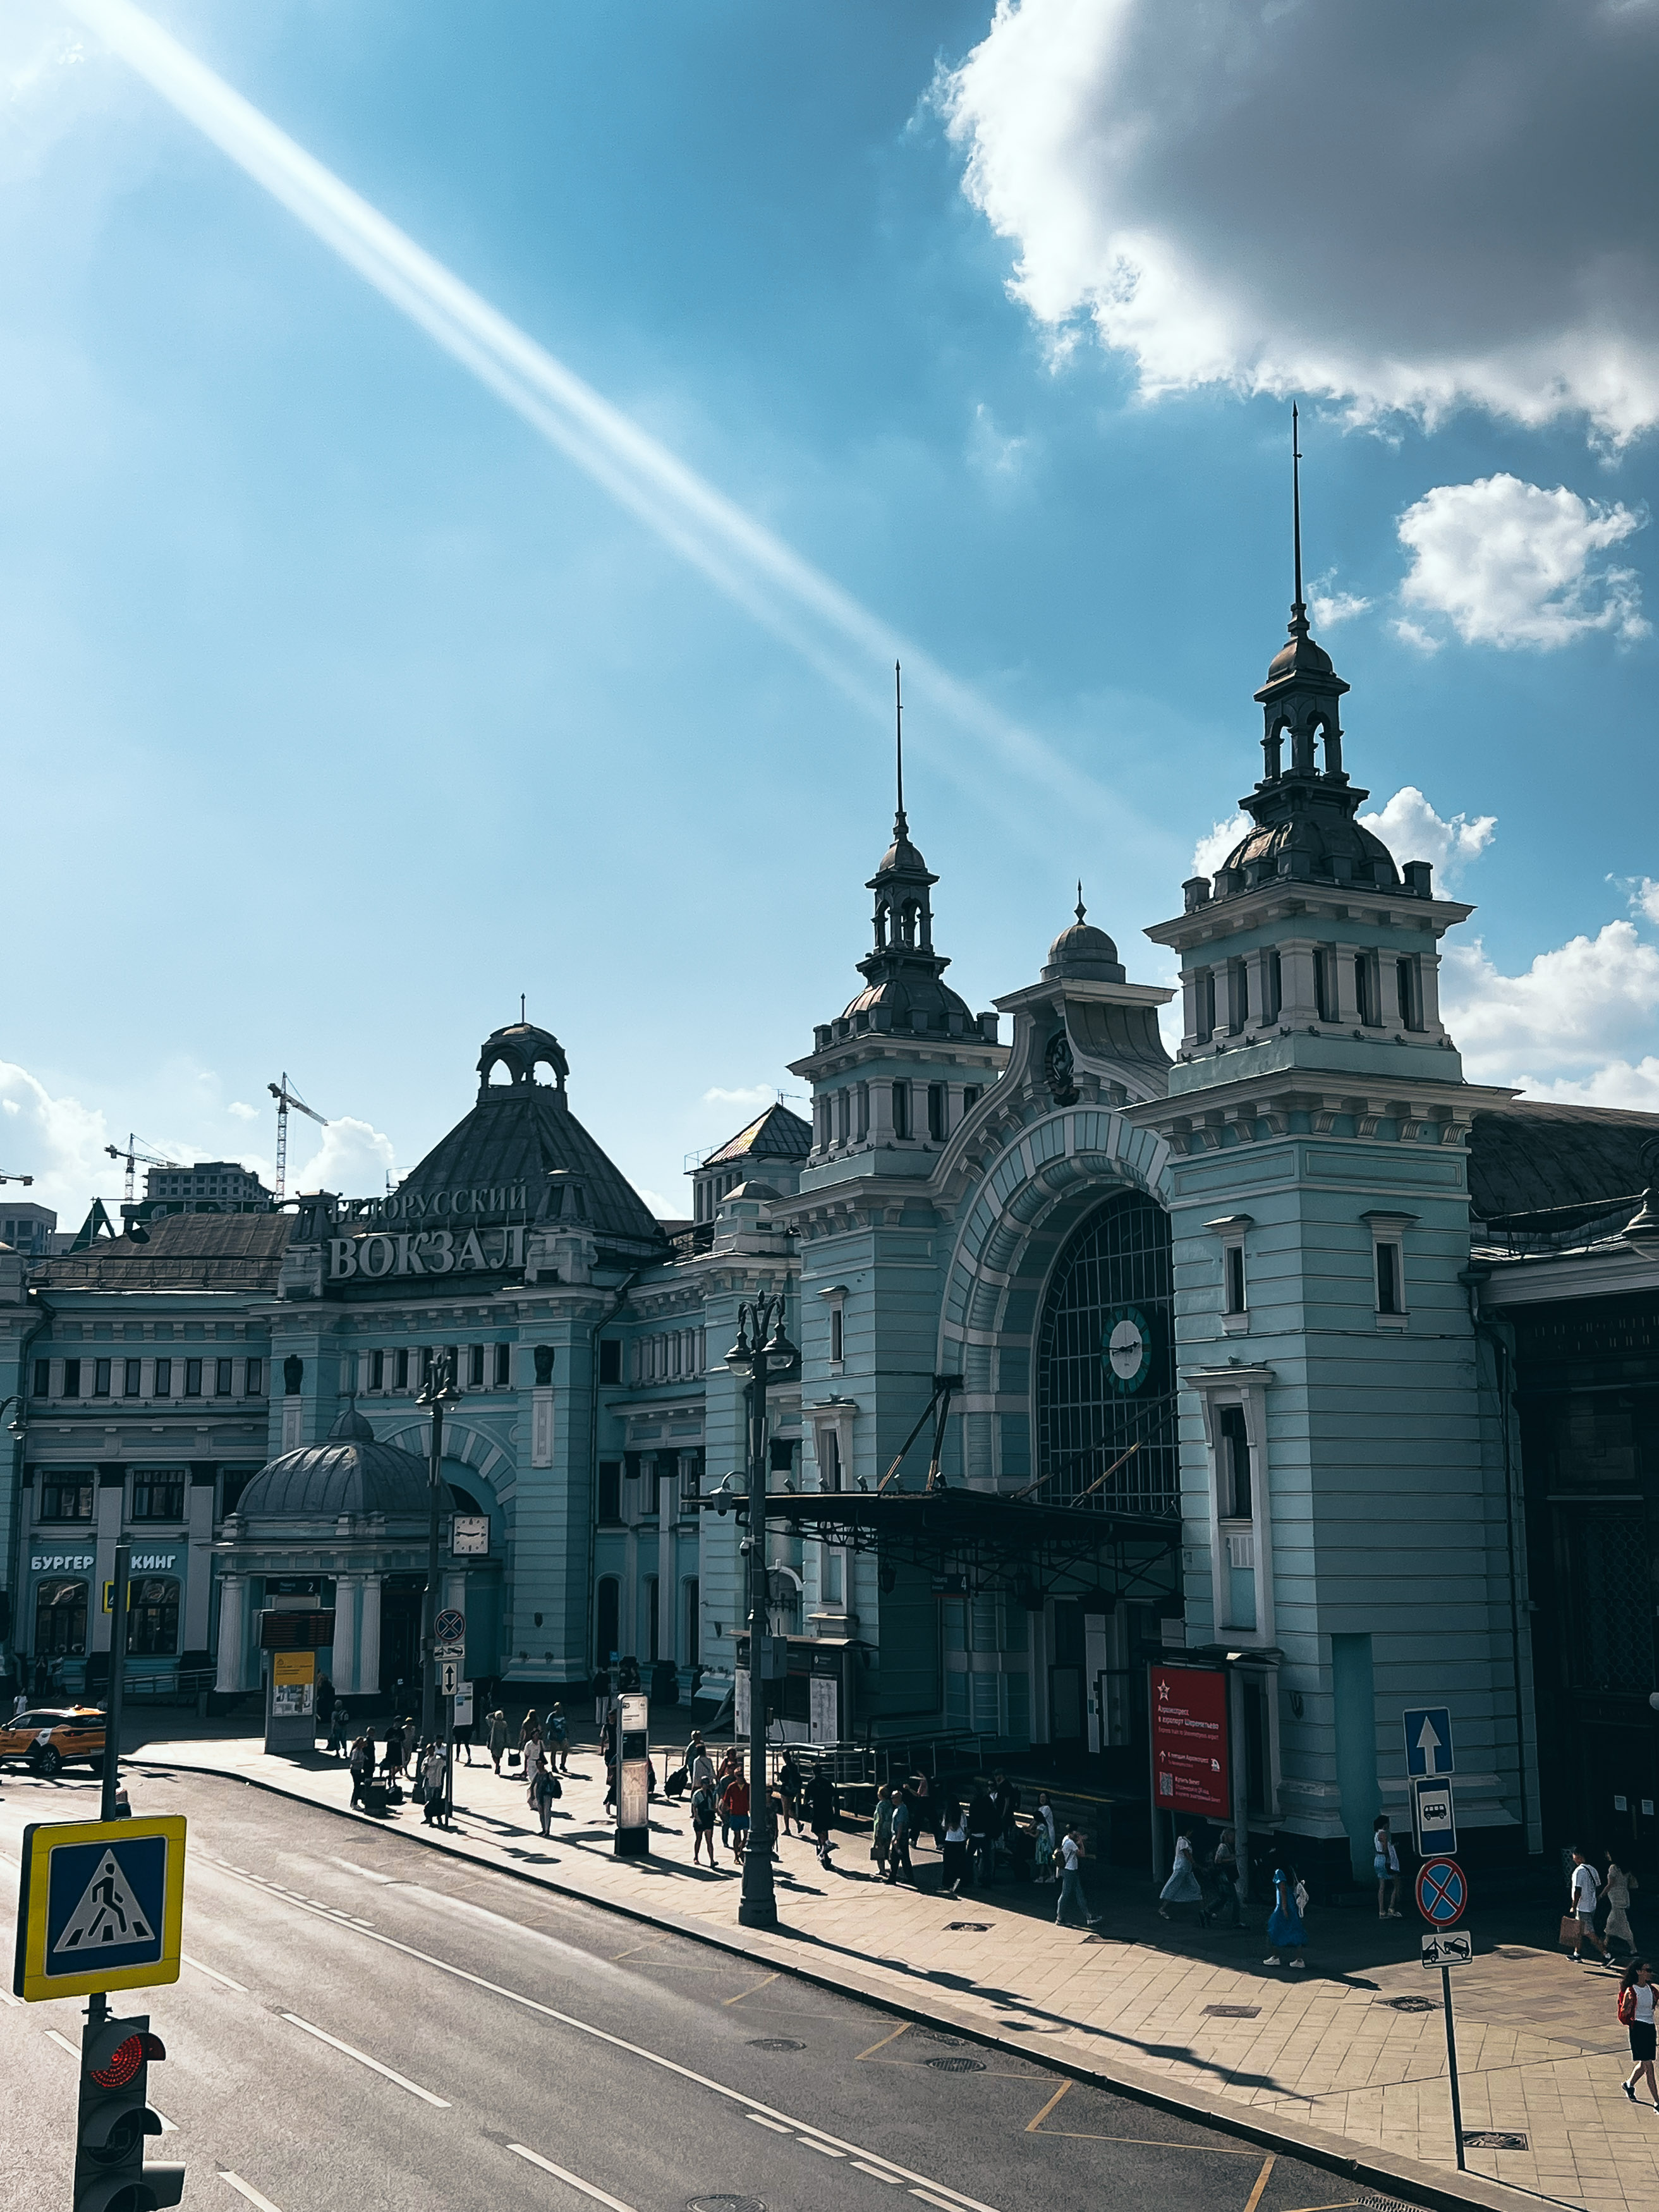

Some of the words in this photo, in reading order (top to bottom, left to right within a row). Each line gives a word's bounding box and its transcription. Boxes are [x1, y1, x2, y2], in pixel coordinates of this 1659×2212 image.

[331, 1177, 526, 1224] БЕЛОРУССКИЙ
[327, 1225, 528, 1279] ВОКЗАЛ
[31, 1555, 95, 1570] БУРГЕР
[131, 1555, 176, 1570] КИНГ
[308, 1582, 314, 1592] 2
[961, 1576, 966, 1590] 4
